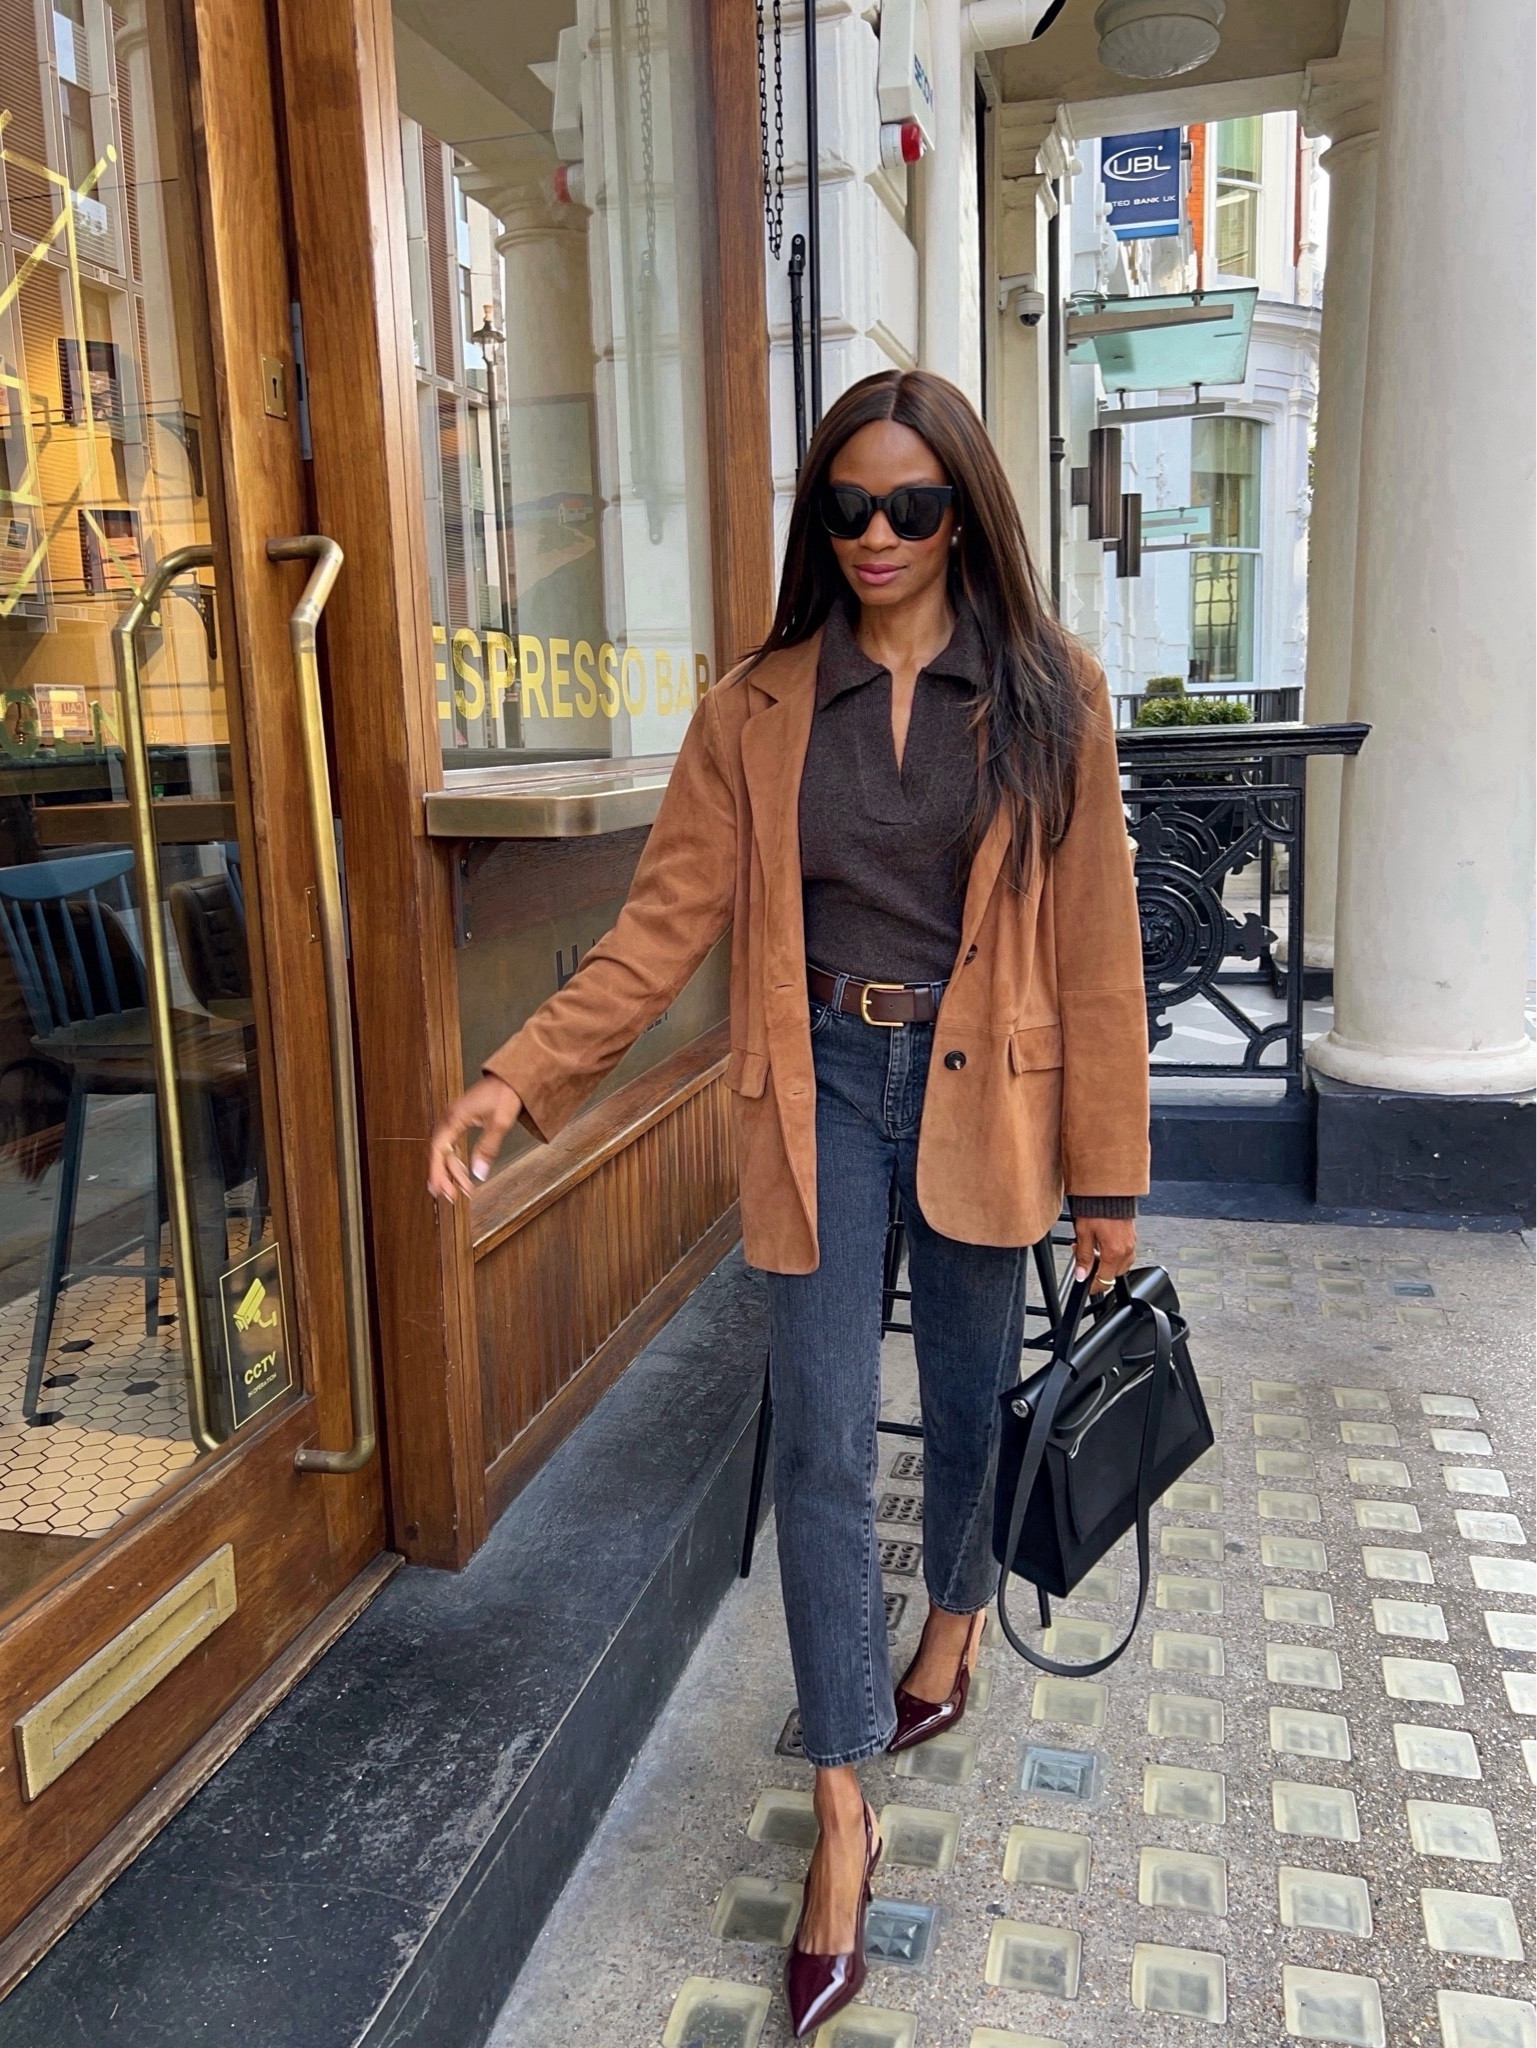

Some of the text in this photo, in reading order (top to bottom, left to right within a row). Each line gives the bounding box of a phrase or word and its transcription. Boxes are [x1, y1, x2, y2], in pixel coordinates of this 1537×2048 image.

[1114, 155, 1171, 175] UBL
[1134, 197, 1160, 205] BANK
[244, 1351, 276, 1385] CCTV
